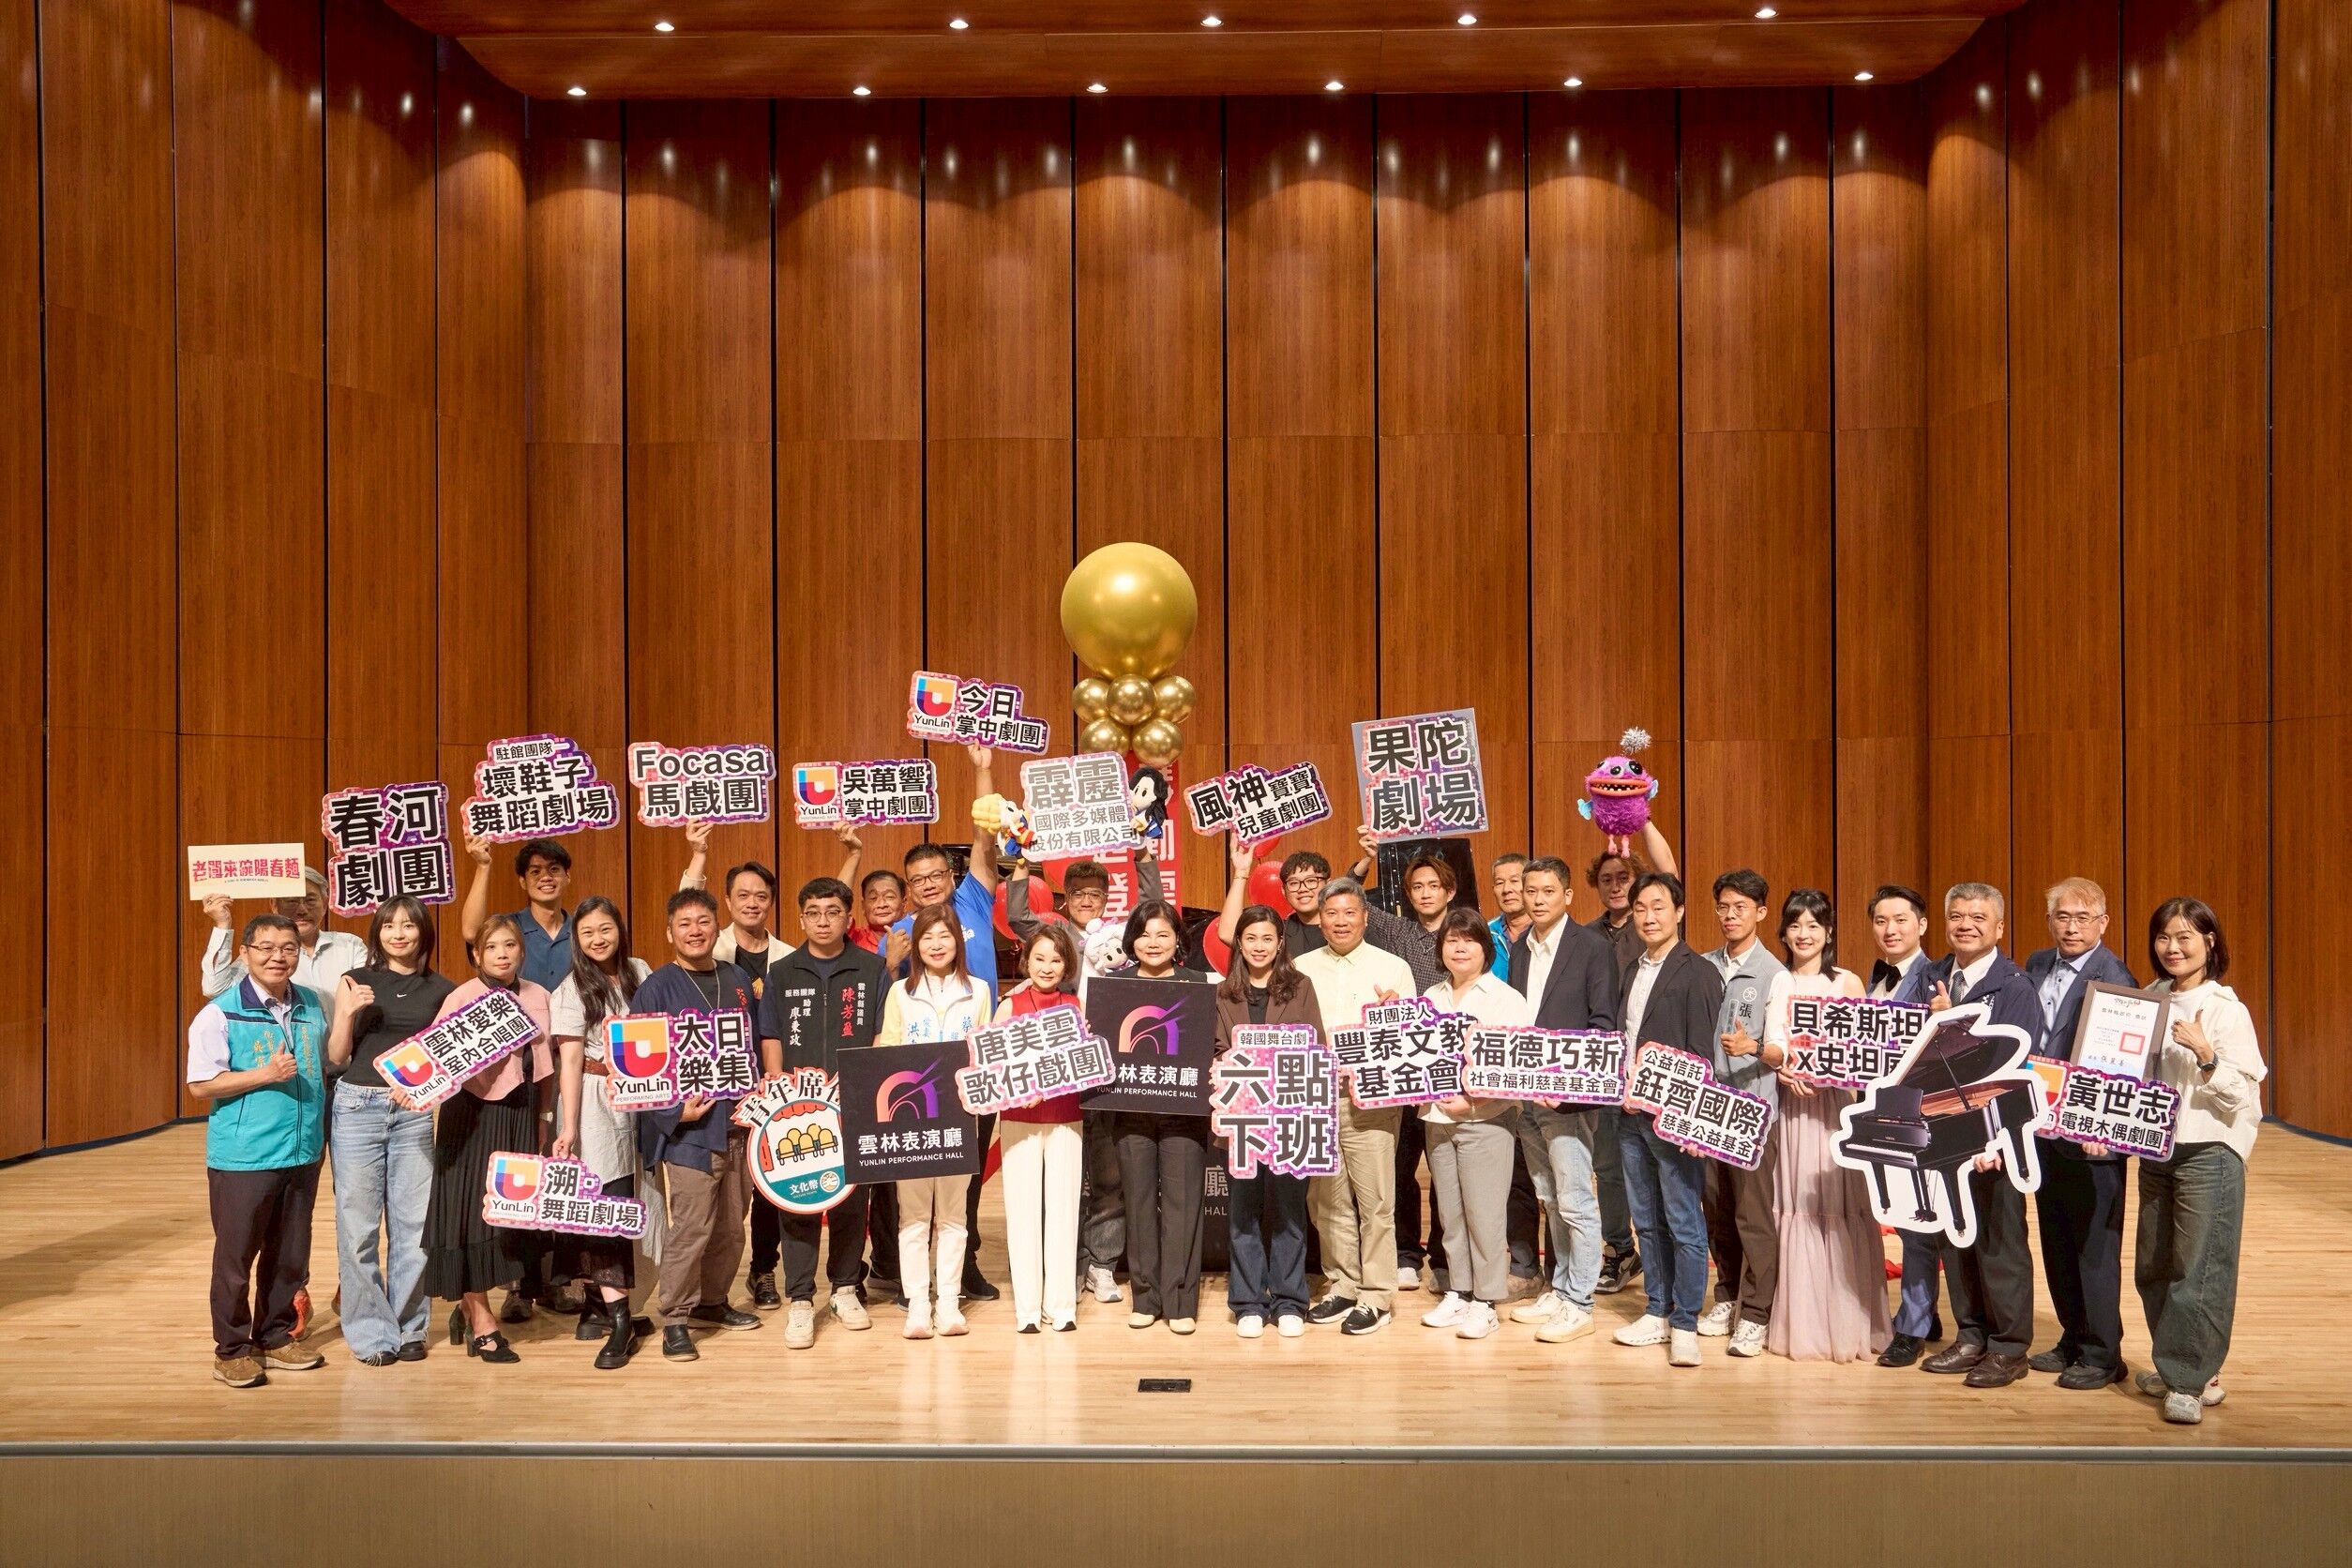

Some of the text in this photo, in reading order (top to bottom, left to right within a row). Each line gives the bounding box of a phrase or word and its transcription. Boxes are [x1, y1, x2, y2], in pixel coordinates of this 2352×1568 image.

[959, 685, 1018, 718] 今日
[914, 715, 949, 728] YunLin
[955, 715, 1042, 746] 掌中劇團
[496, 742, 553, 761] 駐館團隊
[636, 748, 767, 779] Focasa
[1368, 718, 1469, 776] 果陀
[483, 759, 588, 799] 壞鞋子
[646, 777, 761, 818] 馬戲團
[844, 767, 927, 795] 吳萬響
[1029, 759, 1123, 809] 霹靂
[331, 786, 442, 850] 春河
[469, 789, 612, 836] 舞蹈劇場
[800, 806, 837, 815] YunLin
[844, 795, 927, 818] 掌中劇團
[1034, 805, 1127, 833] 國際多媒體
[1237, 795, 1319, 840] 兒童劇團
[1371, 771, 1478, 833] 劇場
[1029, 824, 1138, 852] 股份有限公司
[337, 847, 446, 908] 劇團
[424, 994, 518, 1059] 雲林愛樂
[677, 1014, 747, 1052] 太日
[1368, 1004, 1432, 1025] 財團法人
[1791, 1003, 1922, 1044] 貝希斯坦
[444, 1014, 531, 1078] 室內合唱團
[974, 1012, 1078, 1065] 唐美雲
[1240, 1032, 1306, 1047] 韓國舞台劇
[1334, 1019, 1471, 1065] 豐泰文教
[1473, 1033, 1620, 1076] 福德巧新
[678, 1054, 750, 1093] 樂集
[963, 1041, 1107, 1106] 歌仔戲團
[1118, 1063, 1199, 1086] 林表演廳
[1220, 1052, 1332, 1108] 六點
[1357, 1059, 1458, 1099] 基金會
[1470, 1071, 1618, 1095] 社會福利慈善基金會
[1644, 1049, 1705, 1080] 公益信託
[410, 1077, 446, 1099] YunLin
[614, 1078, 670, 1093] YunLin
[1124, 1088, 1177, 1096] PERFORMANCE
[1633, 1069, 1767, 1138] 鈺齊國際
[2066, 1075, 2171, 1124] 黃世志
[858, 1127, 963, 1154] 雲林表演廳
[1220, 1116, 1333, 1169] 下班
[1661, 1113, 1754, 1158] 慈善公益基金
[2061, 1111, 2164, 1149] 電視木偶劇團
[859, 1158, 886, 1167] YUNLIN
[888, 1153, 943, 1164] PERFORMANCE
[492, 1199, 534, 1213] YunLin
[541, 1198, 640, 1229] 舞蹈劇場
[1204, 1206, 1228, 1215] HAL
